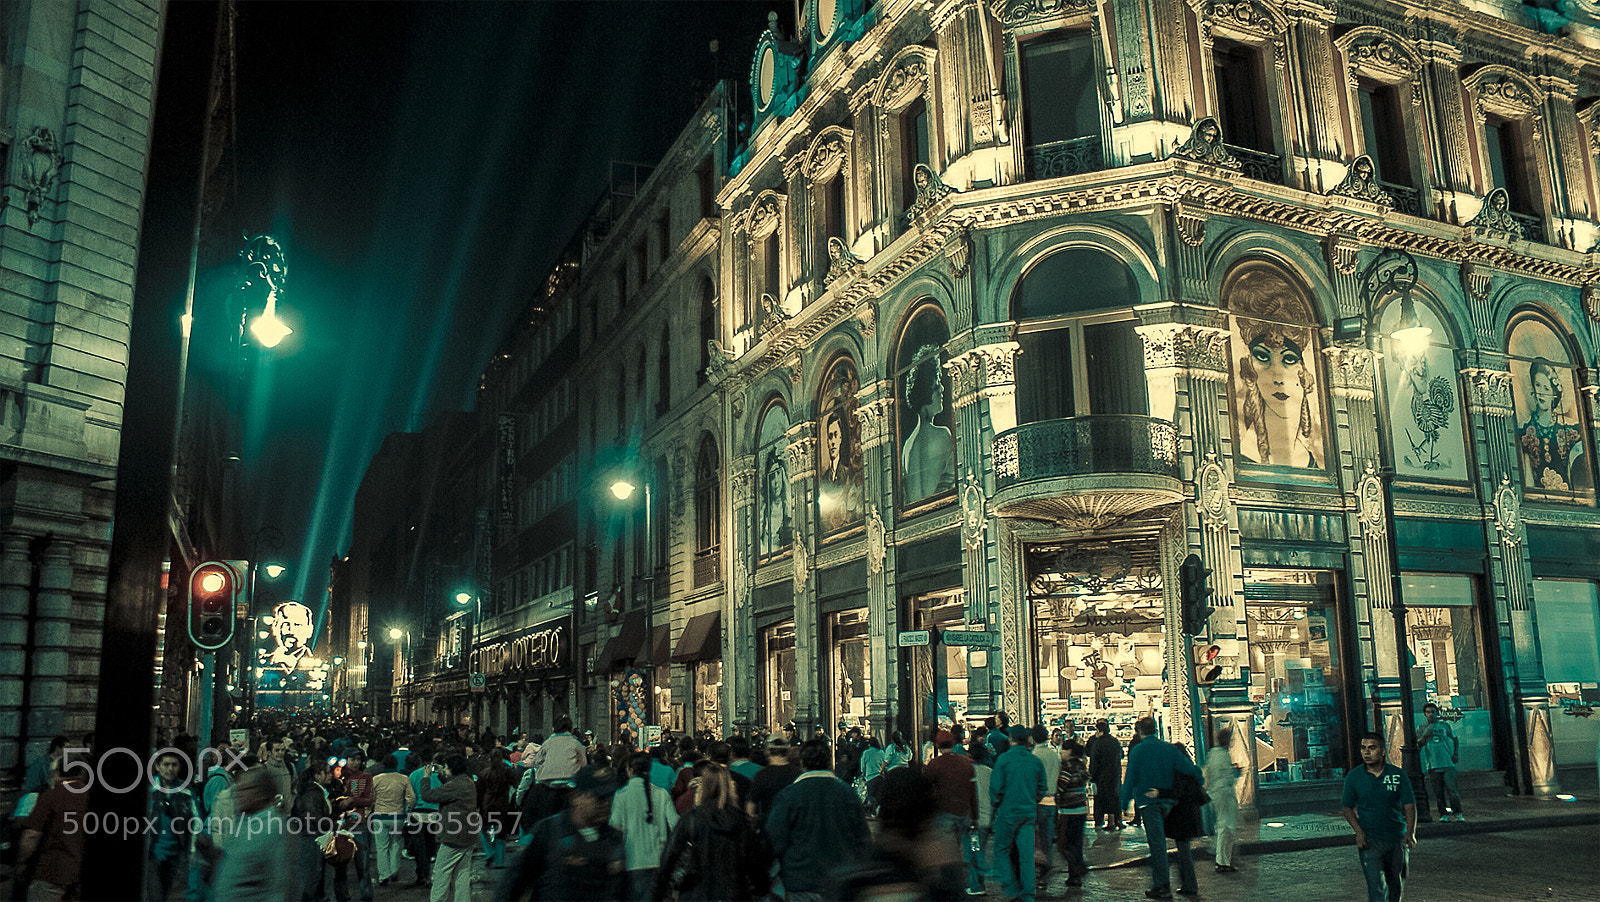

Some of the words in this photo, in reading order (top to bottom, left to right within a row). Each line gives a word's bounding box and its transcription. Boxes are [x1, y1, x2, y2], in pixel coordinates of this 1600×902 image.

[511, 626, 562, 669] JOYERO
[1382, 774, 1401, 784] AE
[1386, 784, 1398, 792] NY
